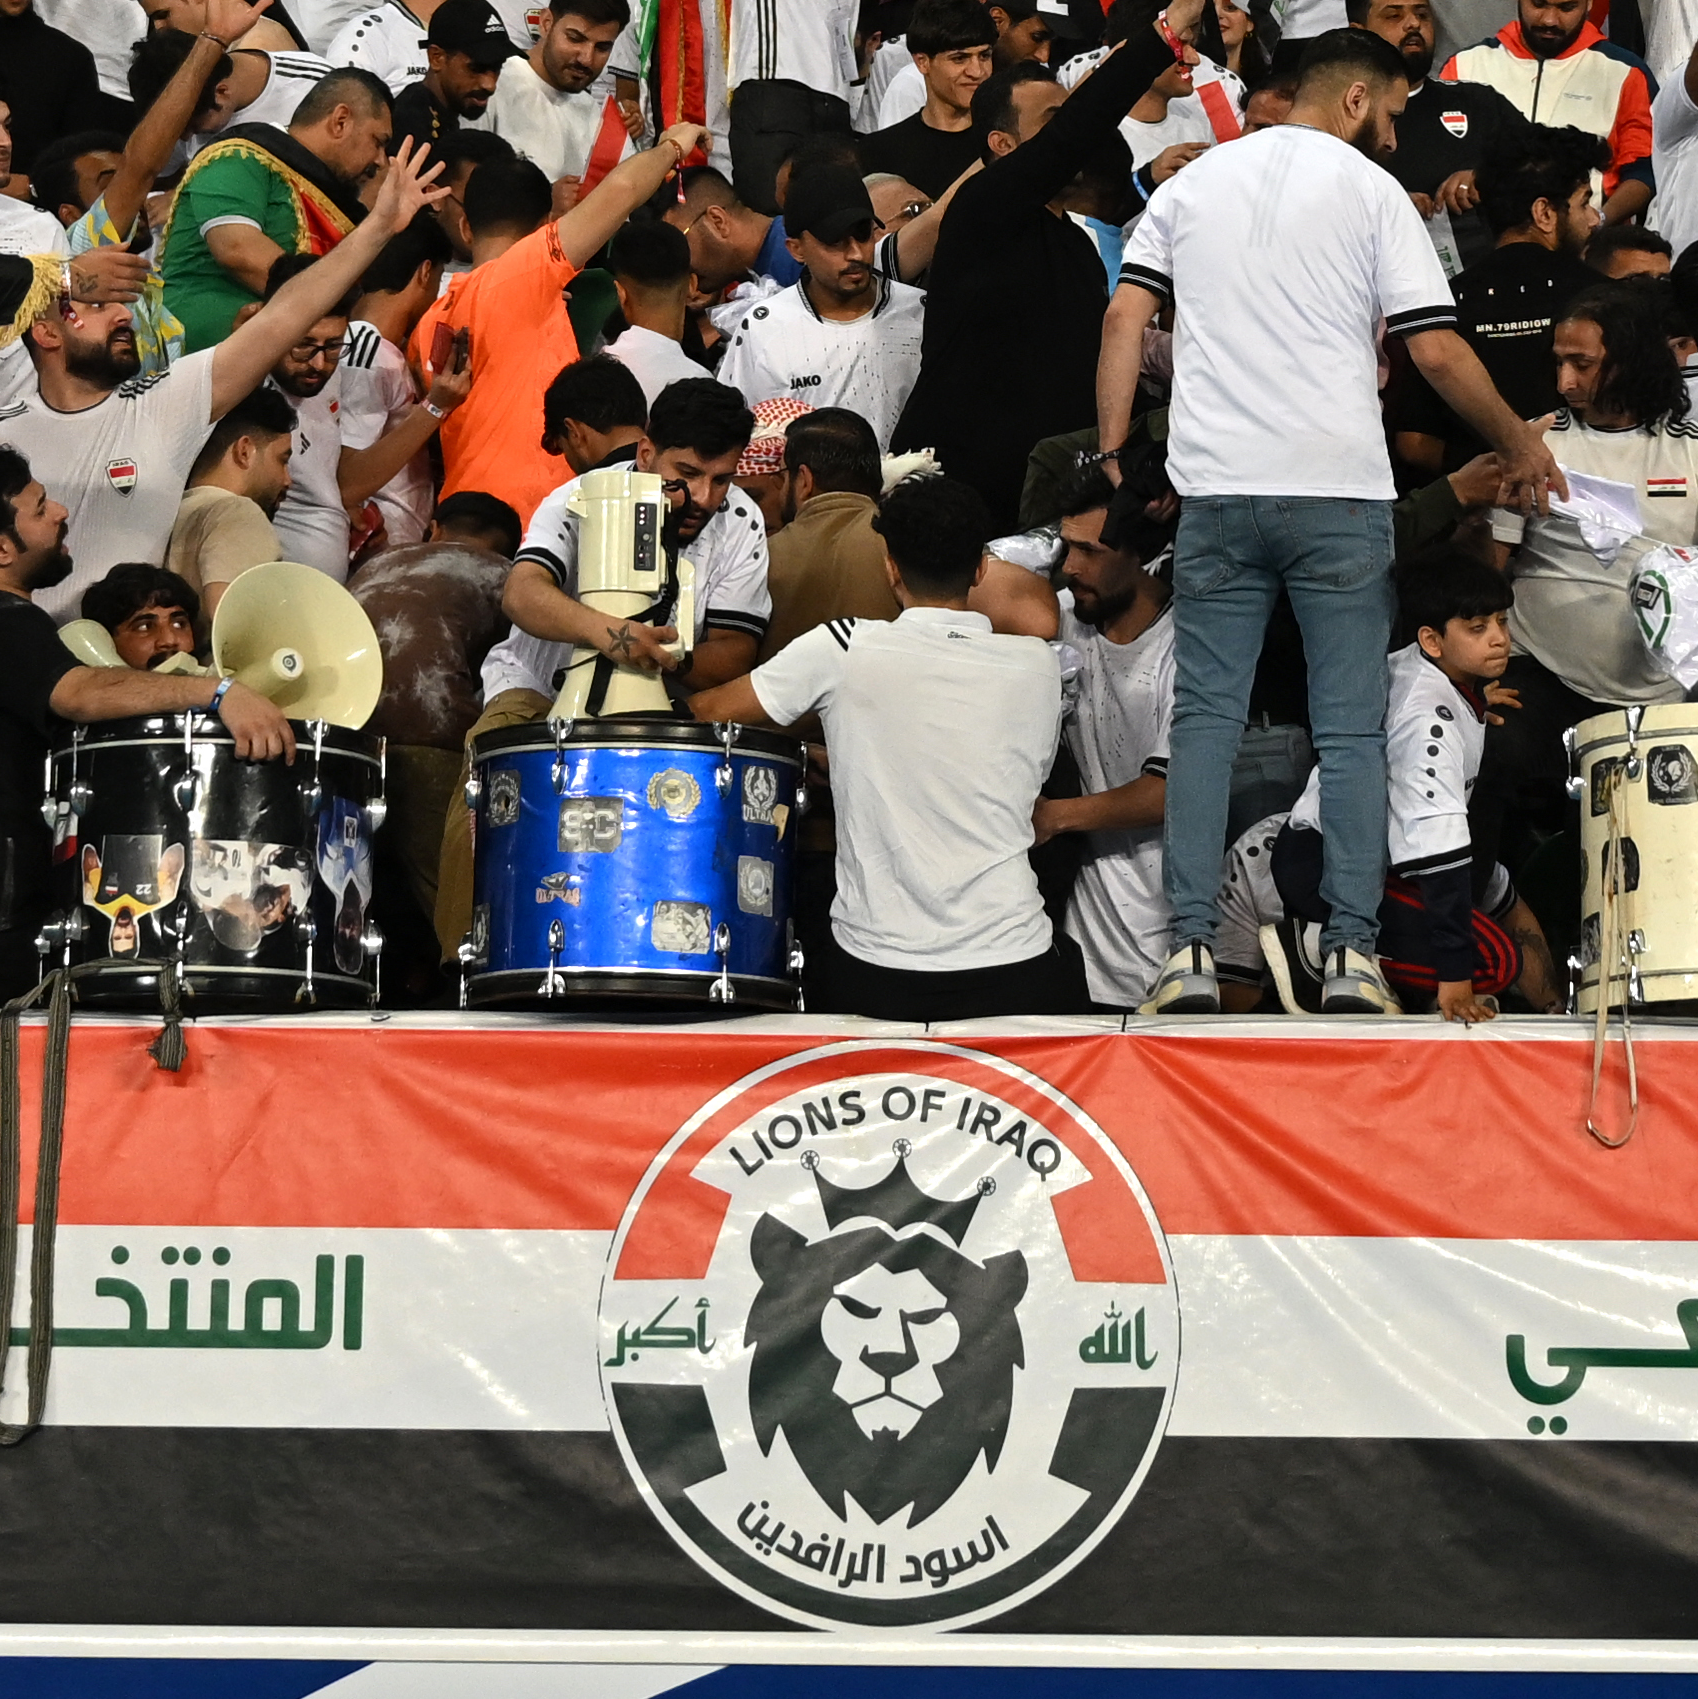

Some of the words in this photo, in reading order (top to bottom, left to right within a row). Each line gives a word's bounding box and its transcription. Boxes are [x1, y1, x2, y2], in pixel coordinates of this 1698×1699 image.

[407, 67, 427, 75] JAKO
[790, 375, 821, 390] JAKO
[729, 1089, 866, 1176] LIONS
[881, 1084, 947, 1123] OF
[956, 1098, 1062, 1180] IRAQ
[1079, 1301, 1158, 1370] الله
[737, 1500, 885, 1587] الرافدين
[900, 1515, 1009, 1589] اسود
